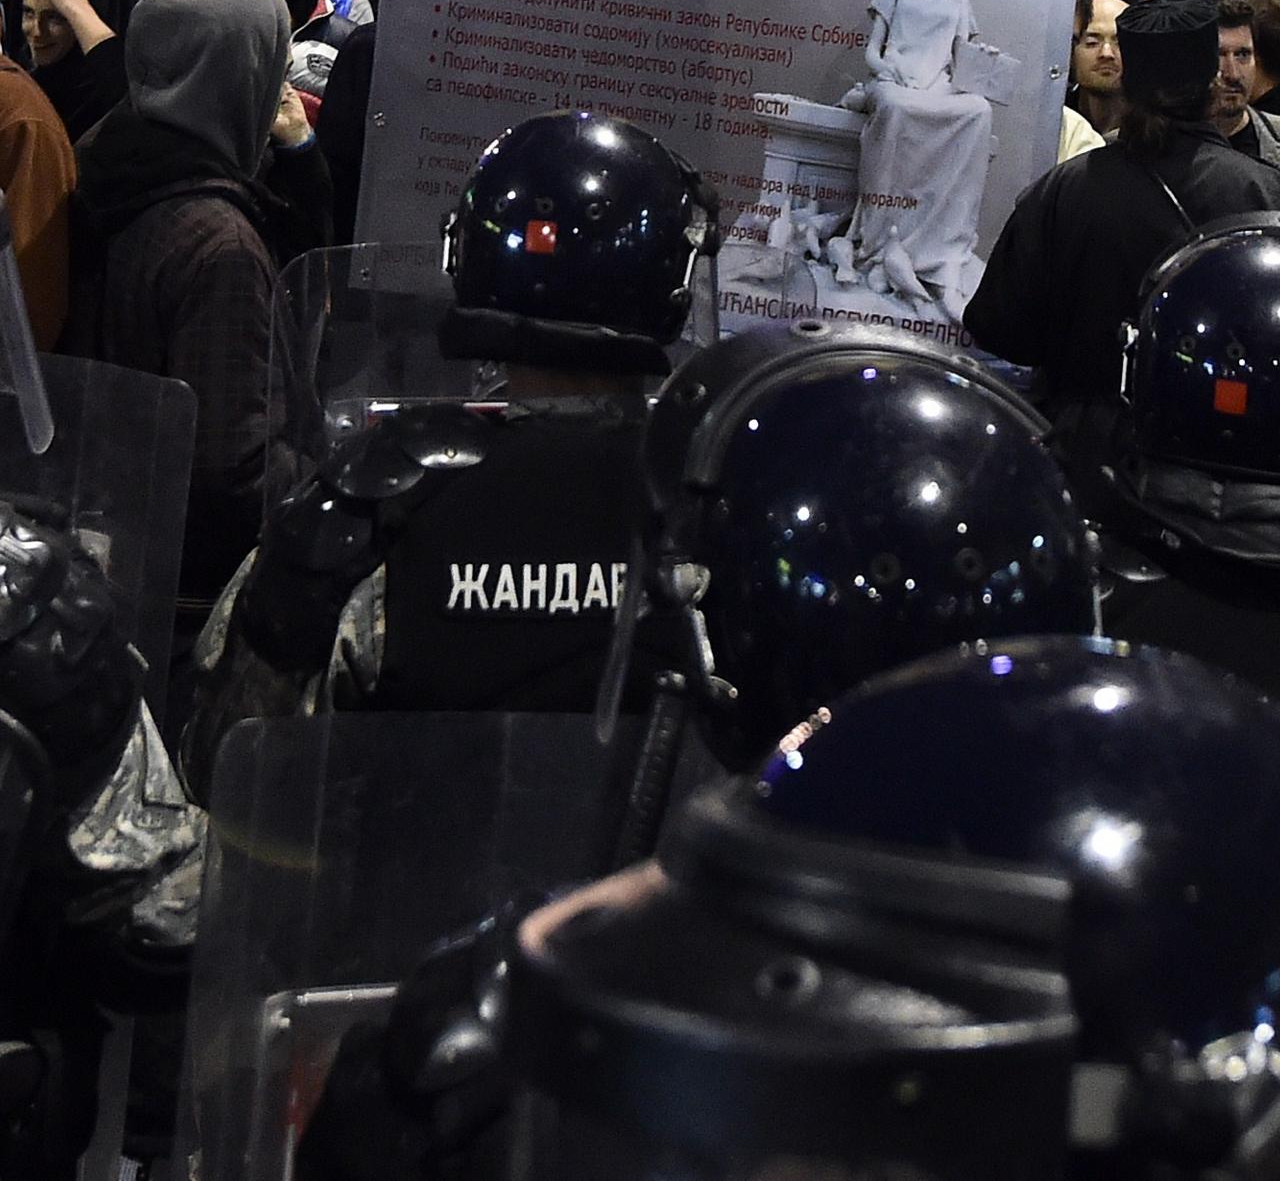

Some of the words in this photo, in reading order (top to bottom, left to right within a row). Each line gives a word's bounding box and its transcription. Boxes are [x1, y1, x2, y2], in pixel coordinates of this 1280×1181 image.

[447, 0, 580, 34] Криминализовати
[582, 23, 651, 49] содомију
[655, 29, 794, 68] (хомосекуализам)
[675, 8, 721, 29] закон
[725, 12, 808, 41] Републике
[442, 51, 500, 74] Подићи
[502, 62, 570, 88] законску
[573, 75, 636, 99] границу
[638, 81, 718, 106] сексуалне
[719, 96, 791, 118] зрелости
[444, 26, 578, 60] Криминализовати
[580, 49, 677, 76] чедоморство
[681, 57, 754, 87] (абортус)
[425, 76, 443, 92] са
[446, 79, 538, 106] педофилске
[553, 91, 572, 111] 14
[694, 112, 713, 132] 18
[736, 202, 782, 219] етиком
[786, 183, 810, 199] над
[861, 192, 919, 210] моралом
